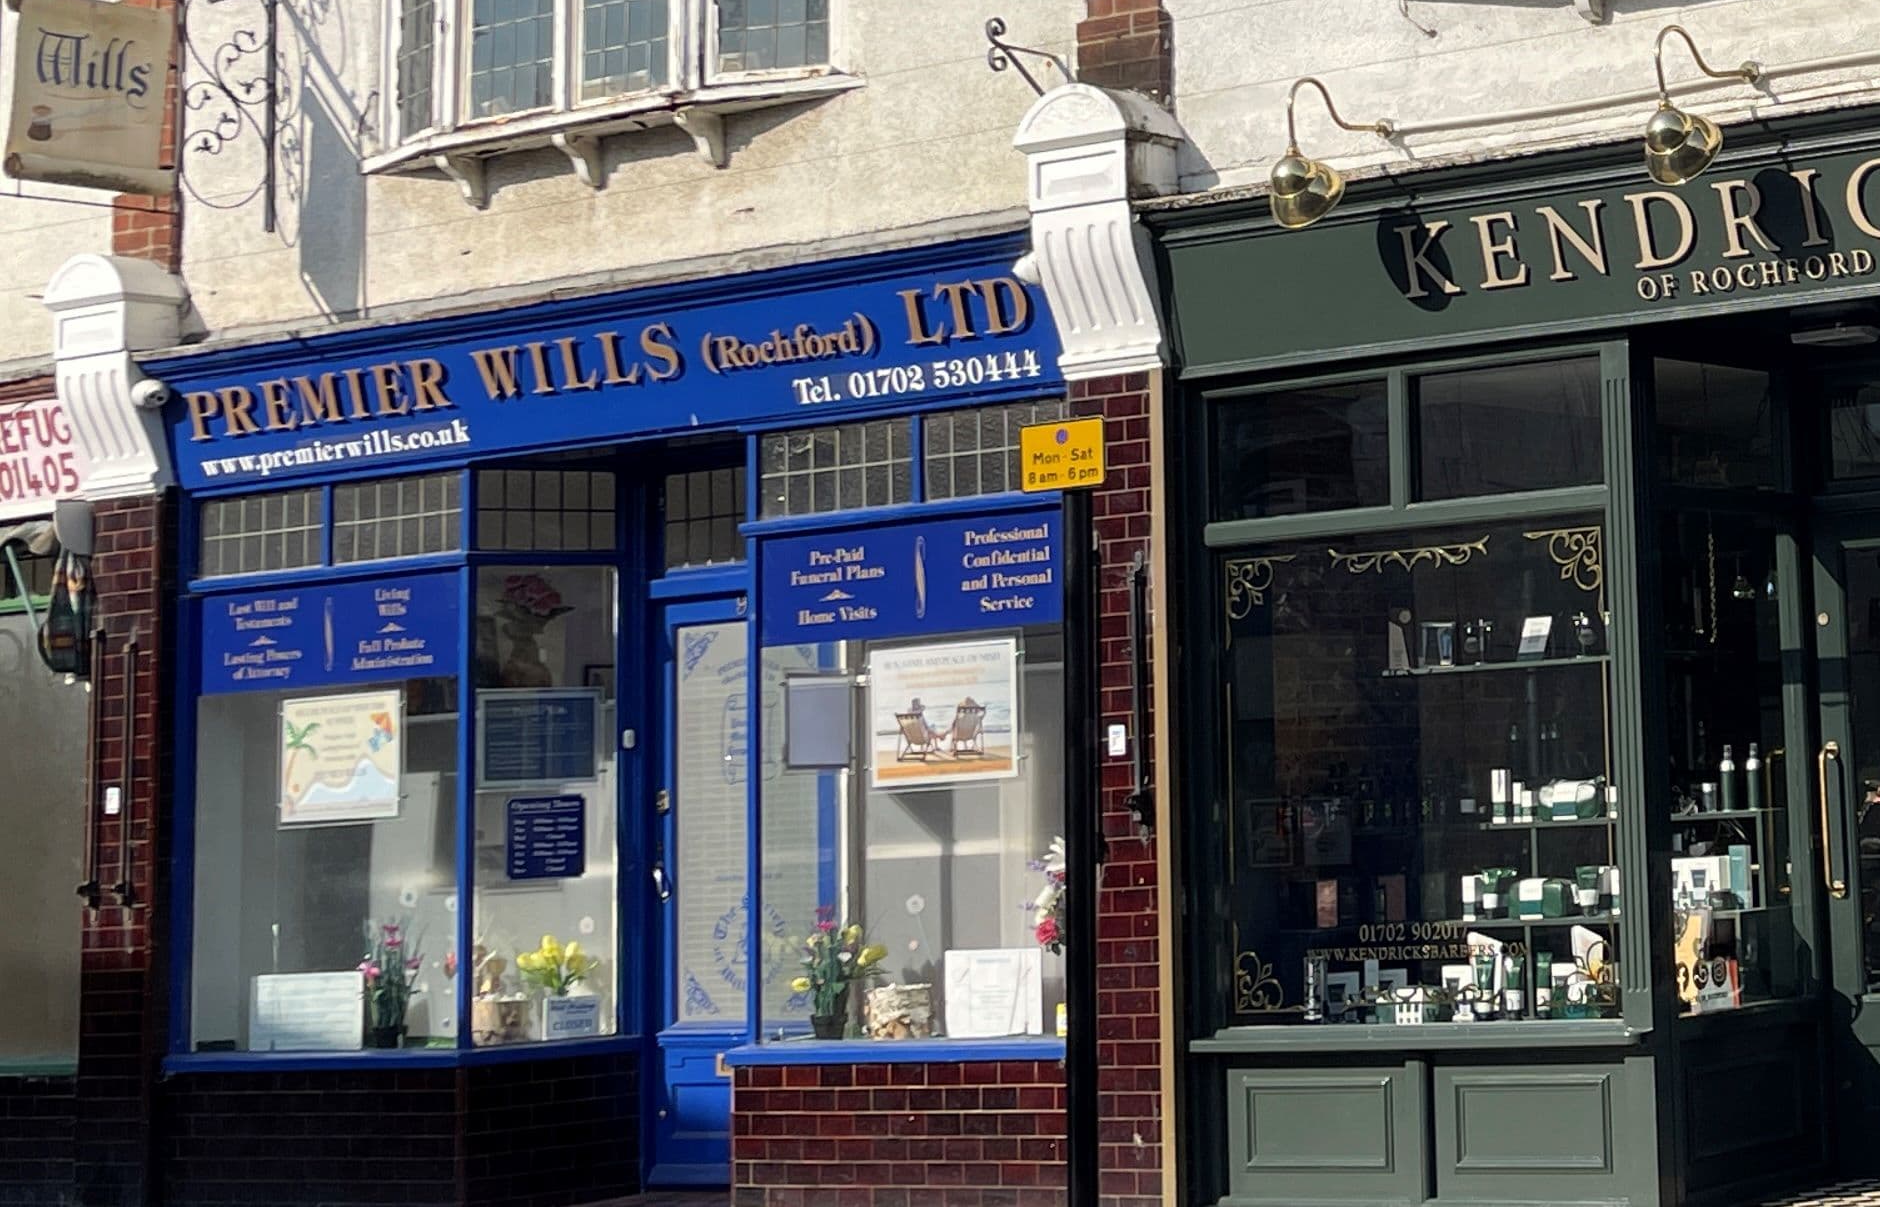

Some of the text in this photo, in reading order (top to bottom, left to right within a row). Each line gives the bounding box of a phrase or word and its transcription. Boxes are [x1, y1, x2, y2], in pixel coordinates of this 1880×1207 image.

[37, 27, 152, 109] Wills
[1636, 249, 1874, 301] OF ROCHFORD
[182, 277, 1028, 442] PREMIER WILLS (Rochford) LTD
[792, 348, 1041, 405] Tel. 01702 530444
[0, 406, 73, 456] EFUG
[201, 419, 470, 476] www.premierwills.co.uk
[1032, 451, 1061, 465] Mon
[1070, 448, 1093, 461] Sat
[964, 523, 1049, 546] Professional
[810, 546, 865, 567] Pre-Paid
[962, 546, 1050, 569] Confidential
[791, 564, 885, 586] Funeral Plans
[961, 568, 1052, 592] and Personal
[375, 587, 411, 602] Living
[980, 595, 1034, 613] Service
[798, 606, 878, 625] Home Visits
[1359, 923, 1405, 942] 01702
